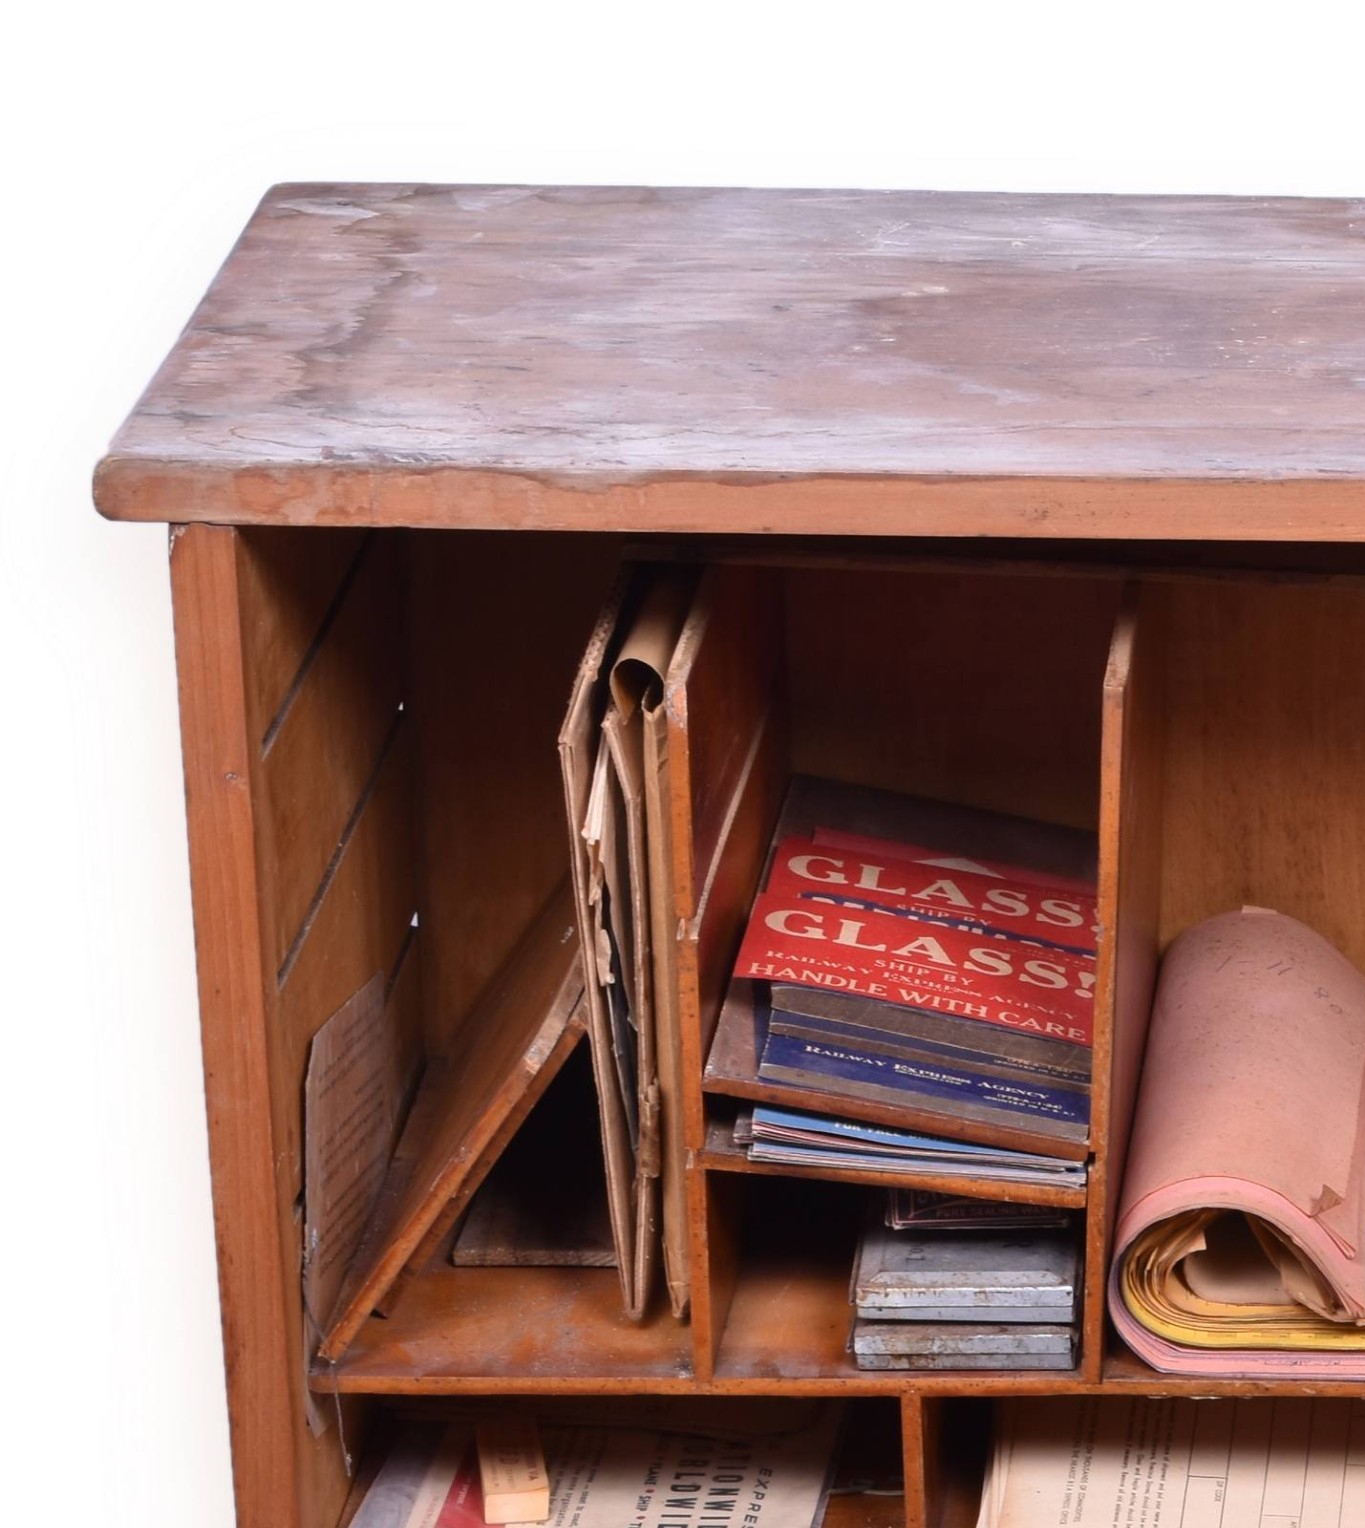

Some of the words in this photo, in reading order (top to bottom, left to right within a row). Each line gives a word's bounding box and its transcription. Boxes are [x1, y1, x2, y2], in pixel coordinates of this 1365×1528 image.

[764, 908, 1097, 999] GLASS!
[873, 958, 931, 977] SHIP
[942, 971, 975, 988] BY
[766, 949, 873, 976] RAILWAY
[882, 971, 983, 999] EXPRESS
[989, 994, 1077, 1022] AGENCY
[748, 962, 890, 998] HANDLE
[898, 988, 990, 1020] WITH
[997, 1010, 1087, 1043] CARE
[804, 1043, 888, 1069] RAILWAY
[892, 1063, 973, 1086] EXPRESS
[976, 1080, 1051, 1101] AGENCY
[643, 1461, 660, 1486] PLANE
[1068, 1459, 1079, 1480] NEAREST
[1080, 1455, 1093, 1484] THOUSANDS
[1134, 1467, 1142, 1476] and
[1079, 1484, 1088, 1492] OF
[1157, 1482, 1166, 1491] and
[1212, 1489, 1223, 1503] CODE
[635, 1494, 648, 1512] SHIP
[1073, 1492, 1088, 1524] COMMODITIES
[1127, 1508, 1136, 1522] should
[1153, 1511, 1161, 1523] name
